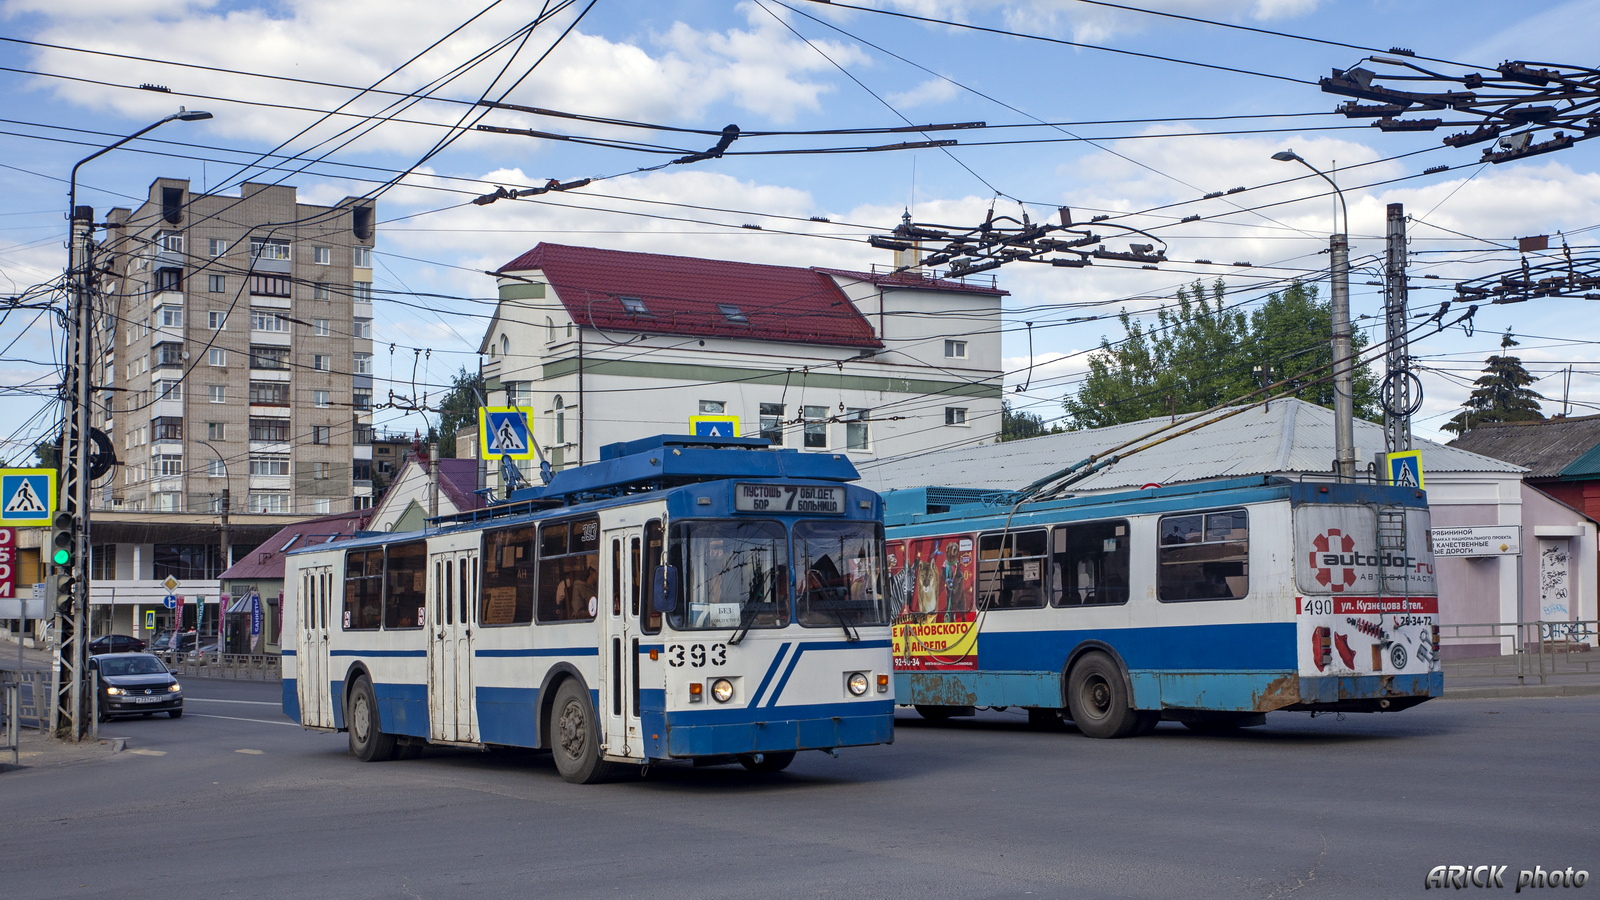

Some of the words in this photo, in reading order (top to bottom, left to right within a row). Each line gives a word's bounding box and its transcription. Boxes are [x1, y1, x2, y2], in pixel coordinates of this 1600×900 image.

[743, 486, 781, 498] ПУСТОШЬ
[784, 487, 798, 510] 7
[800, 488, 835, 500] ОБЛ.ДЕТ.
[753, 499, 769, 510] БОР
[798, 500, 837, 512] БОЛЬНИЦА
[581, 523, 597, 541] 393
[1323, 551, 1433, 575] autodoc.ru
[718, 607, 732, 615] БЕЗ
[1304, 600, 1332, 615] 490
[1341, 601, 1354, 612] ул.
[1356, 600, 1400, 612] Кузнецова
[1402, 600, 1407, 609] 8
[1408, 602, 1423, 610] тел.
[691, 604, 711, 628] 7
[911, 641, 947, 652] АПРЕЛЯ
[669, 643, 726, 667] 393
